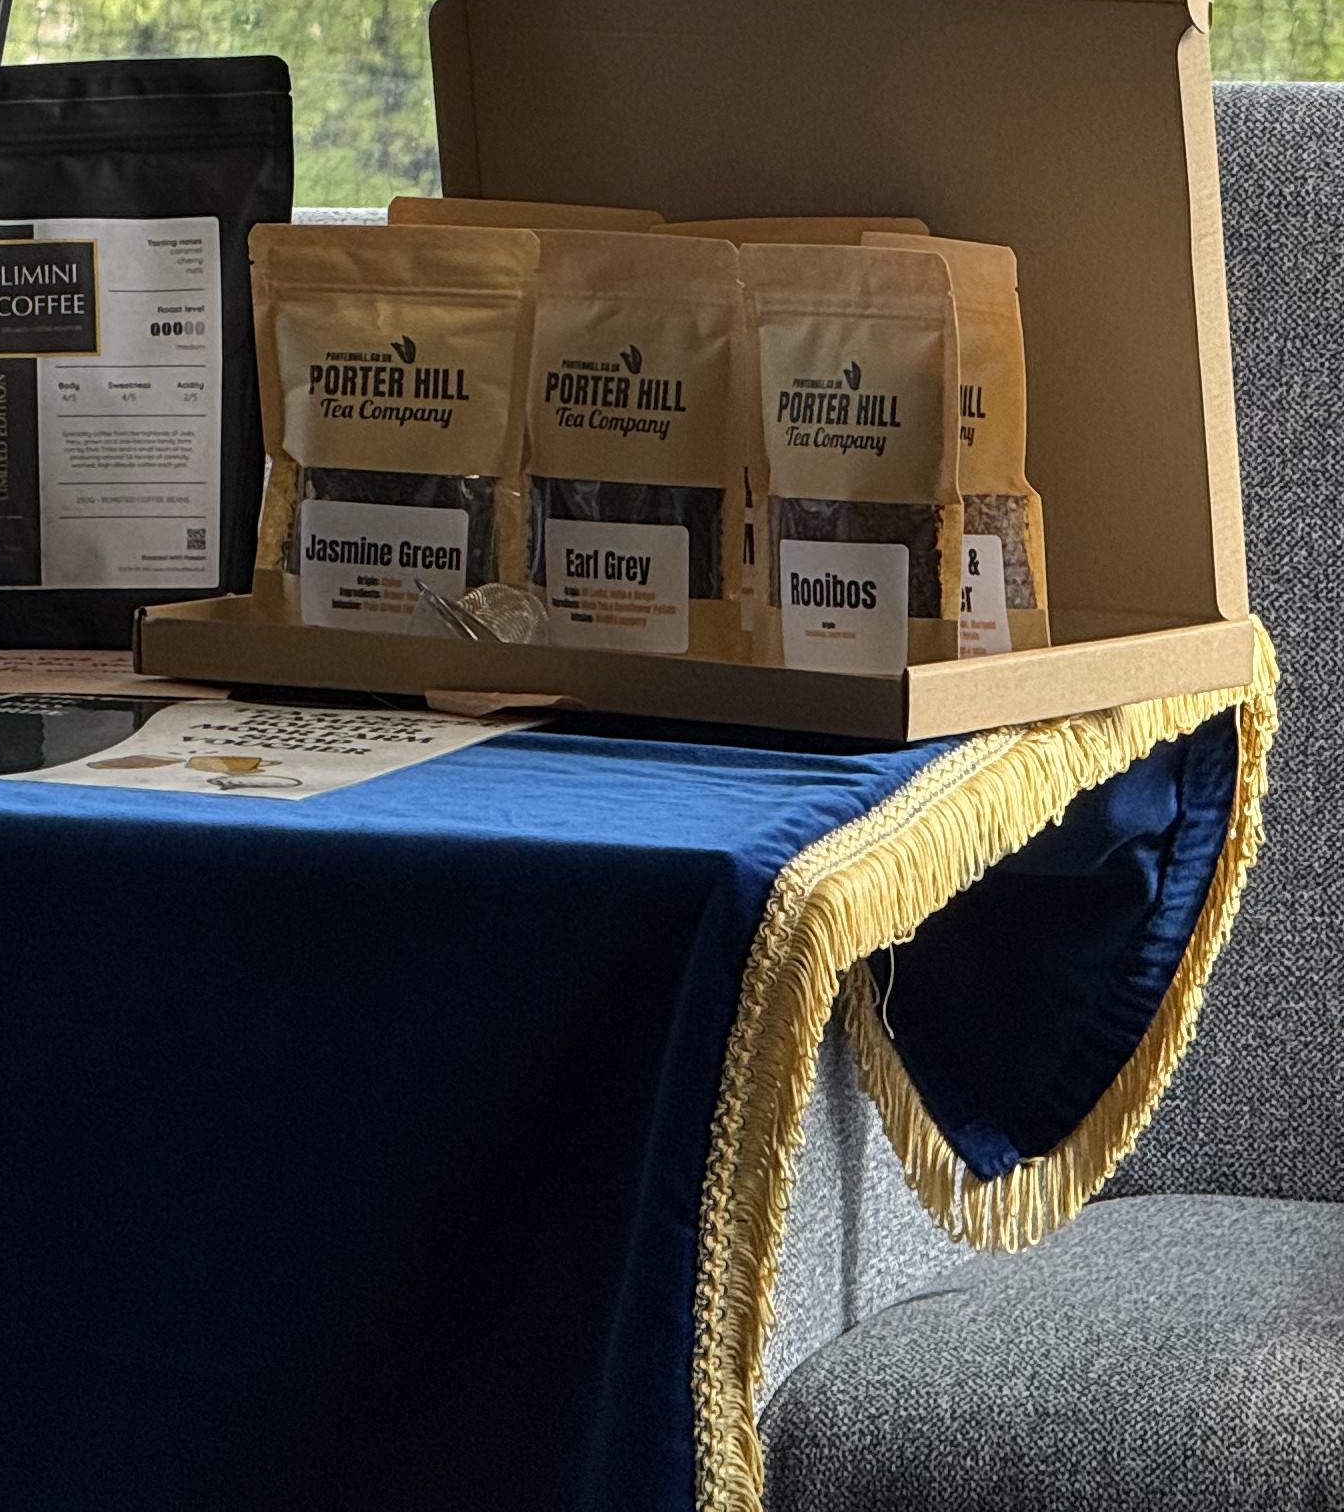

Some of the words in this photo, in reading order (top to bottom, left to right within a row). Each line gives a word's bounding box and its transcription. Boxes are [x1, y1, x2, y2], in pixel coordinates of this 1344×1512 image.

[1, 264, 77, 286] LIMINI
[309, 365, 404, 398] PORTER
[414, 368, 470, 400] HILL
[545, 372, 630, 408] PORTER
[637, 378, 686, 412] HILL
[320, 398, 353, 419] Tea
[359, 400, 452, 428] Company
[556, 407, 584, 427] Tea
[589, 409, 670, 440] Company
[777, 391, 850, 425] PORTER
[856, 394, 901, 427] HILL
[786, 426, 810, 447] Tea
[814, 427, 887, 457] Company
[306, 534, 392, 566] Jasmine
[398, 541, 461, 571] Green
[566, 548, 599, 579] Earl
[605, 550, 651, 586] Grey
[968, 548, 980, 576] &
[791, 572, 877, 610] Rooibos
[183, 736, 371, 755] VOUCHER
